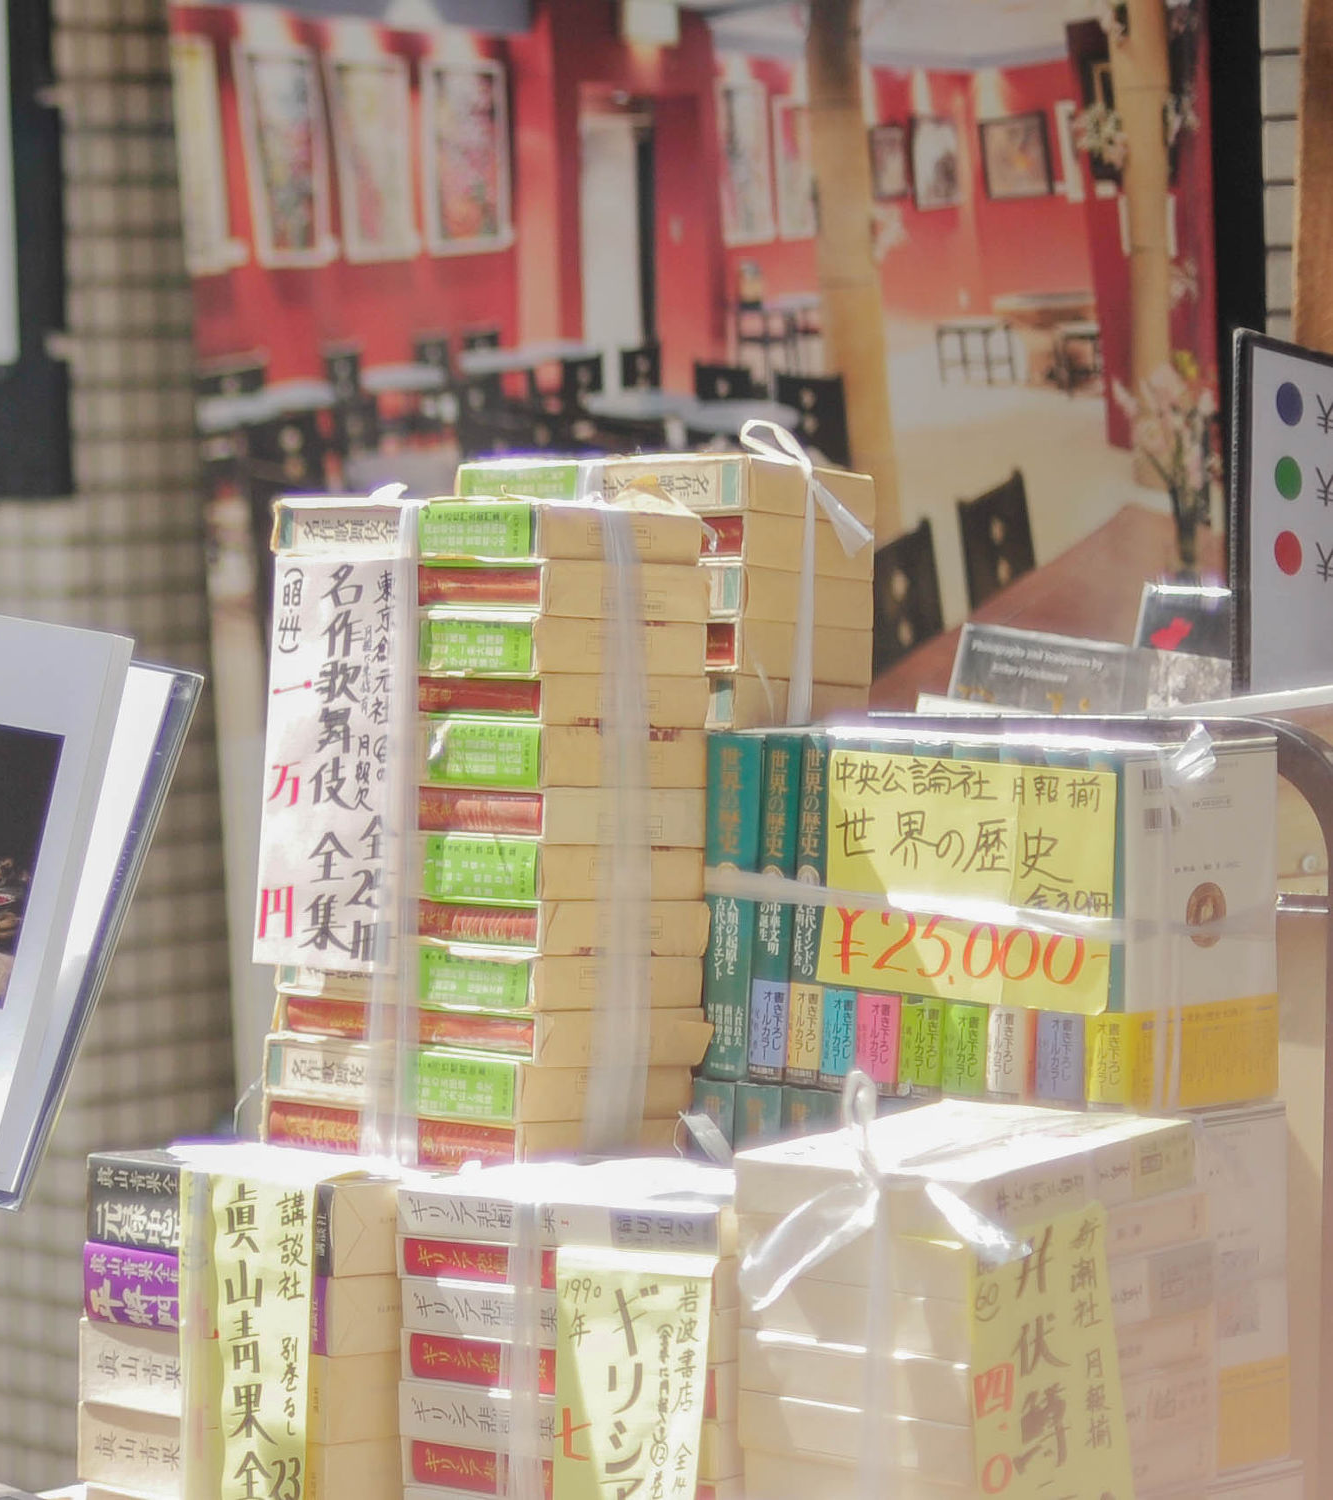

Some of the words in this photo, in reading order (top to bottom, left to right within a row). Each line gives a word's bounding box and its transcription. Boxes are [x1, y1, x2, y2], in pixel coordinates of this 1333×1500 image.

[719, 747, 743, 855] 世界の歴史
[765, 749, 789, 858] 世界の歴史
[802, 749, 825, 858] 世界の歴史
[835, 757, 998, 800] 中央公論社
[836, 807, 1074, 884] 世界の歴史
[276, 1190, 308, 1301] 講談社
[1070, 1217, 1103, 1329] 新潮社
[672, 1282, 700, 1412] 岩波書店
